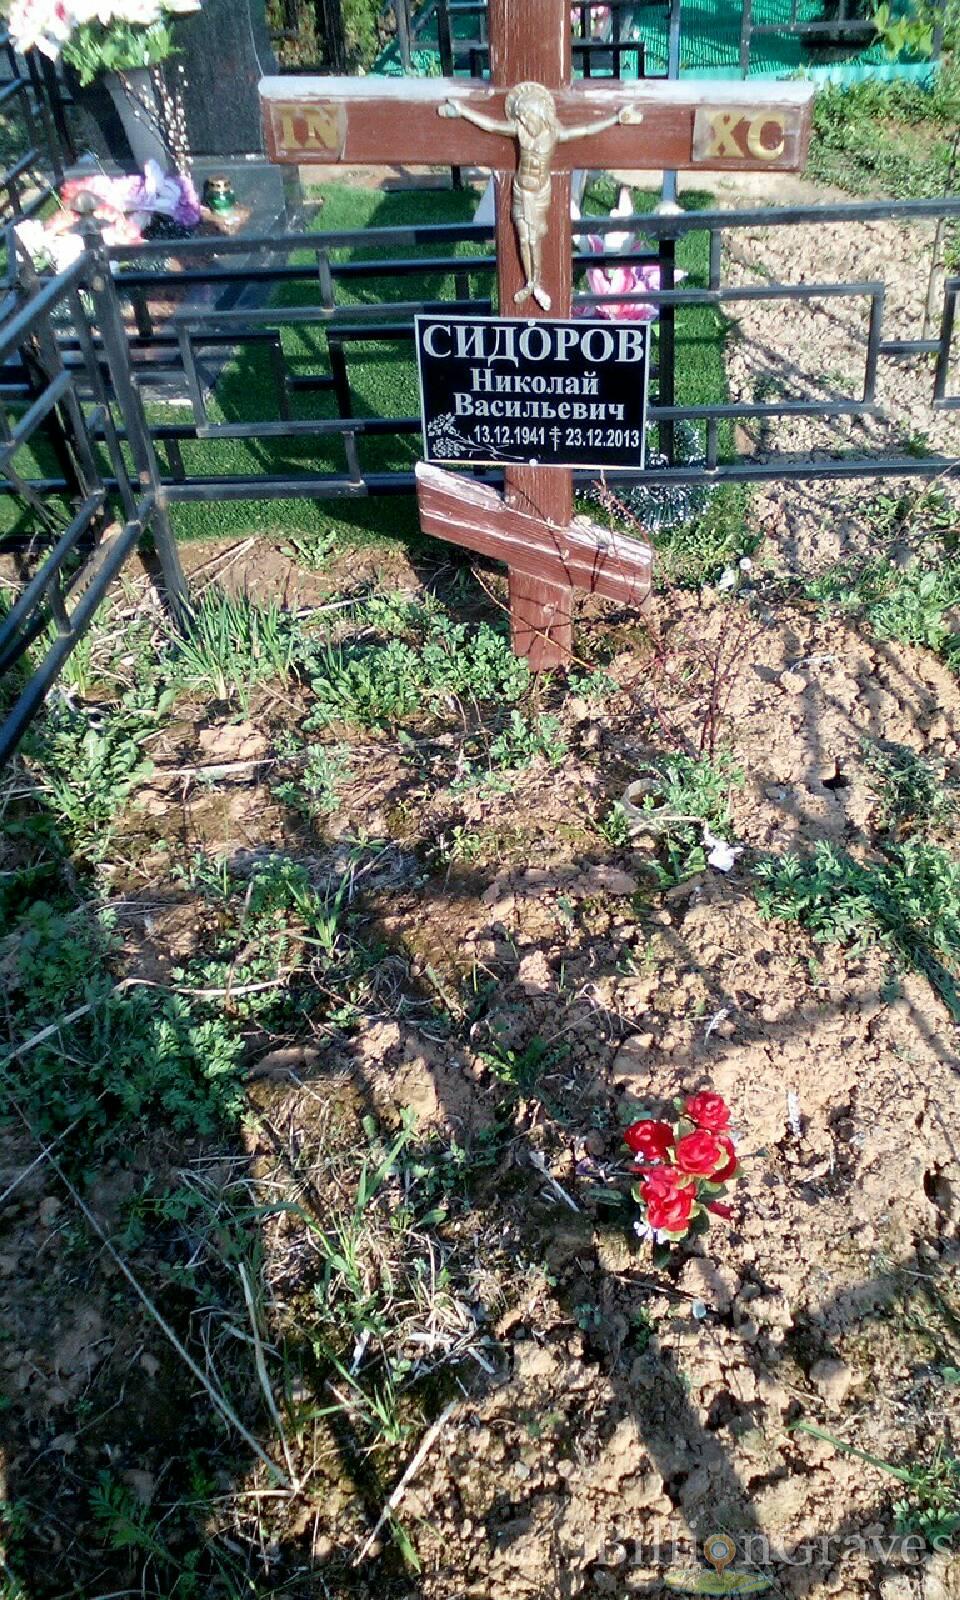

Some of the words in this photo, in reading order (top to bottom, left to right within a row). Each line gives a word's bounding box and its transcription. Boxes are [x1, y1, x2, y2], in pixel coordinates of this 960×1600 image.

[422, 324, 644, 367] СИДОРОВ
[470, 367, 600, 395] Николай
[453, 393, 625, 421] Васильевич
[473, 425, 545, 446] 13.12.1941
[565, 428, 640, 447] 23.12.2013
